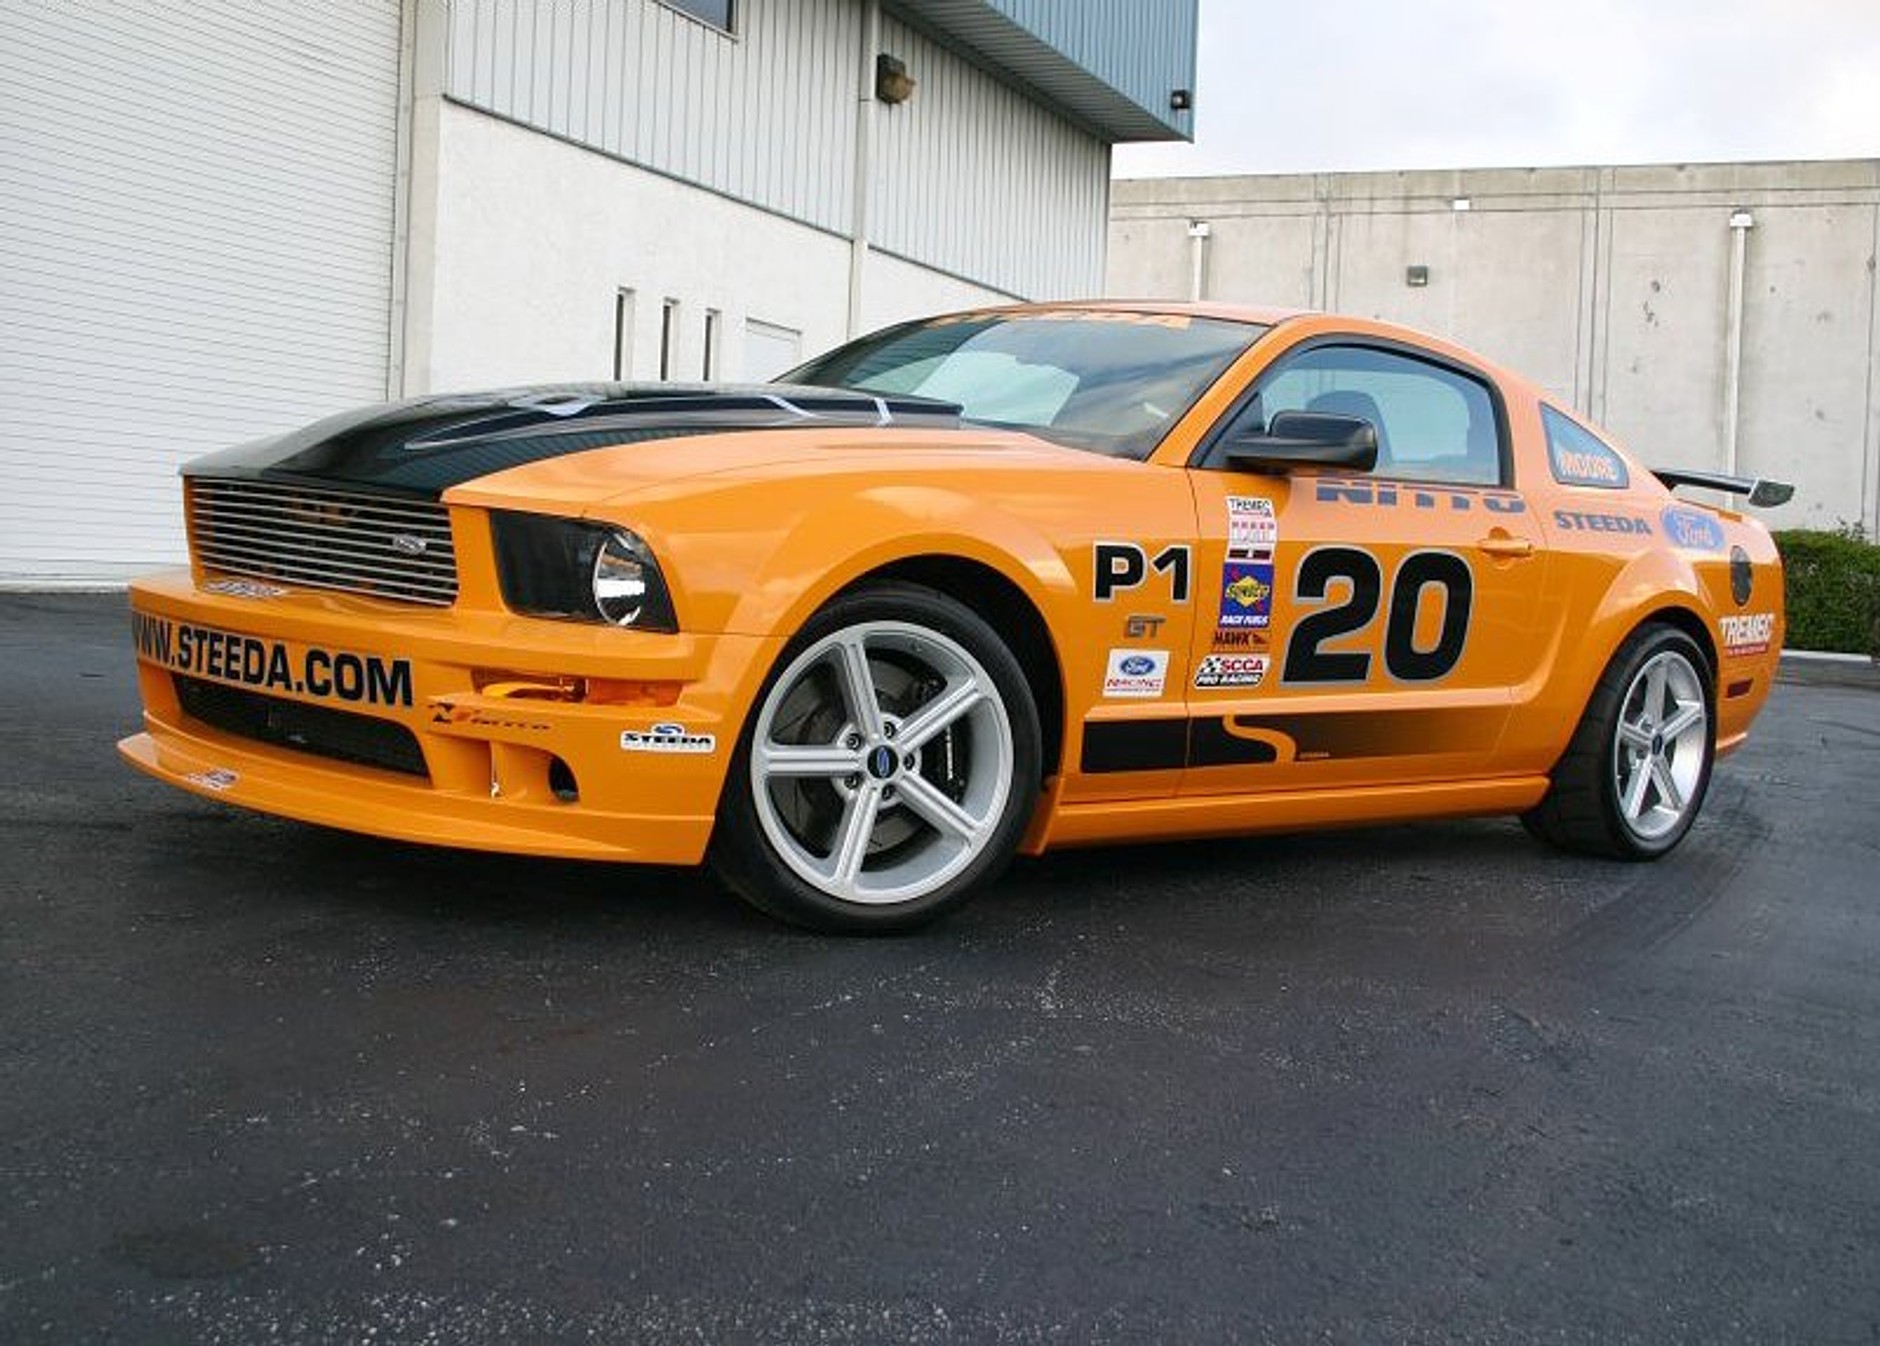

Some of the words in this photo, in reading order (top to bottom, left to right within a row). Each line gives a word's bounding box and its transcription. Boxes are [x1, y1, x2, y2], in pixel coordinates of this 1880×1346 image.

[1553, 510, 1652, 535] STEEDA
[1093, 542, 1191, 602] P1
[1123, 615, 1166, 638] GT
[1280, 544, 1475, 687] 20
[1220, 659, 1264, 673] SCCA
[624, 733, 711, 744] STEEDA
